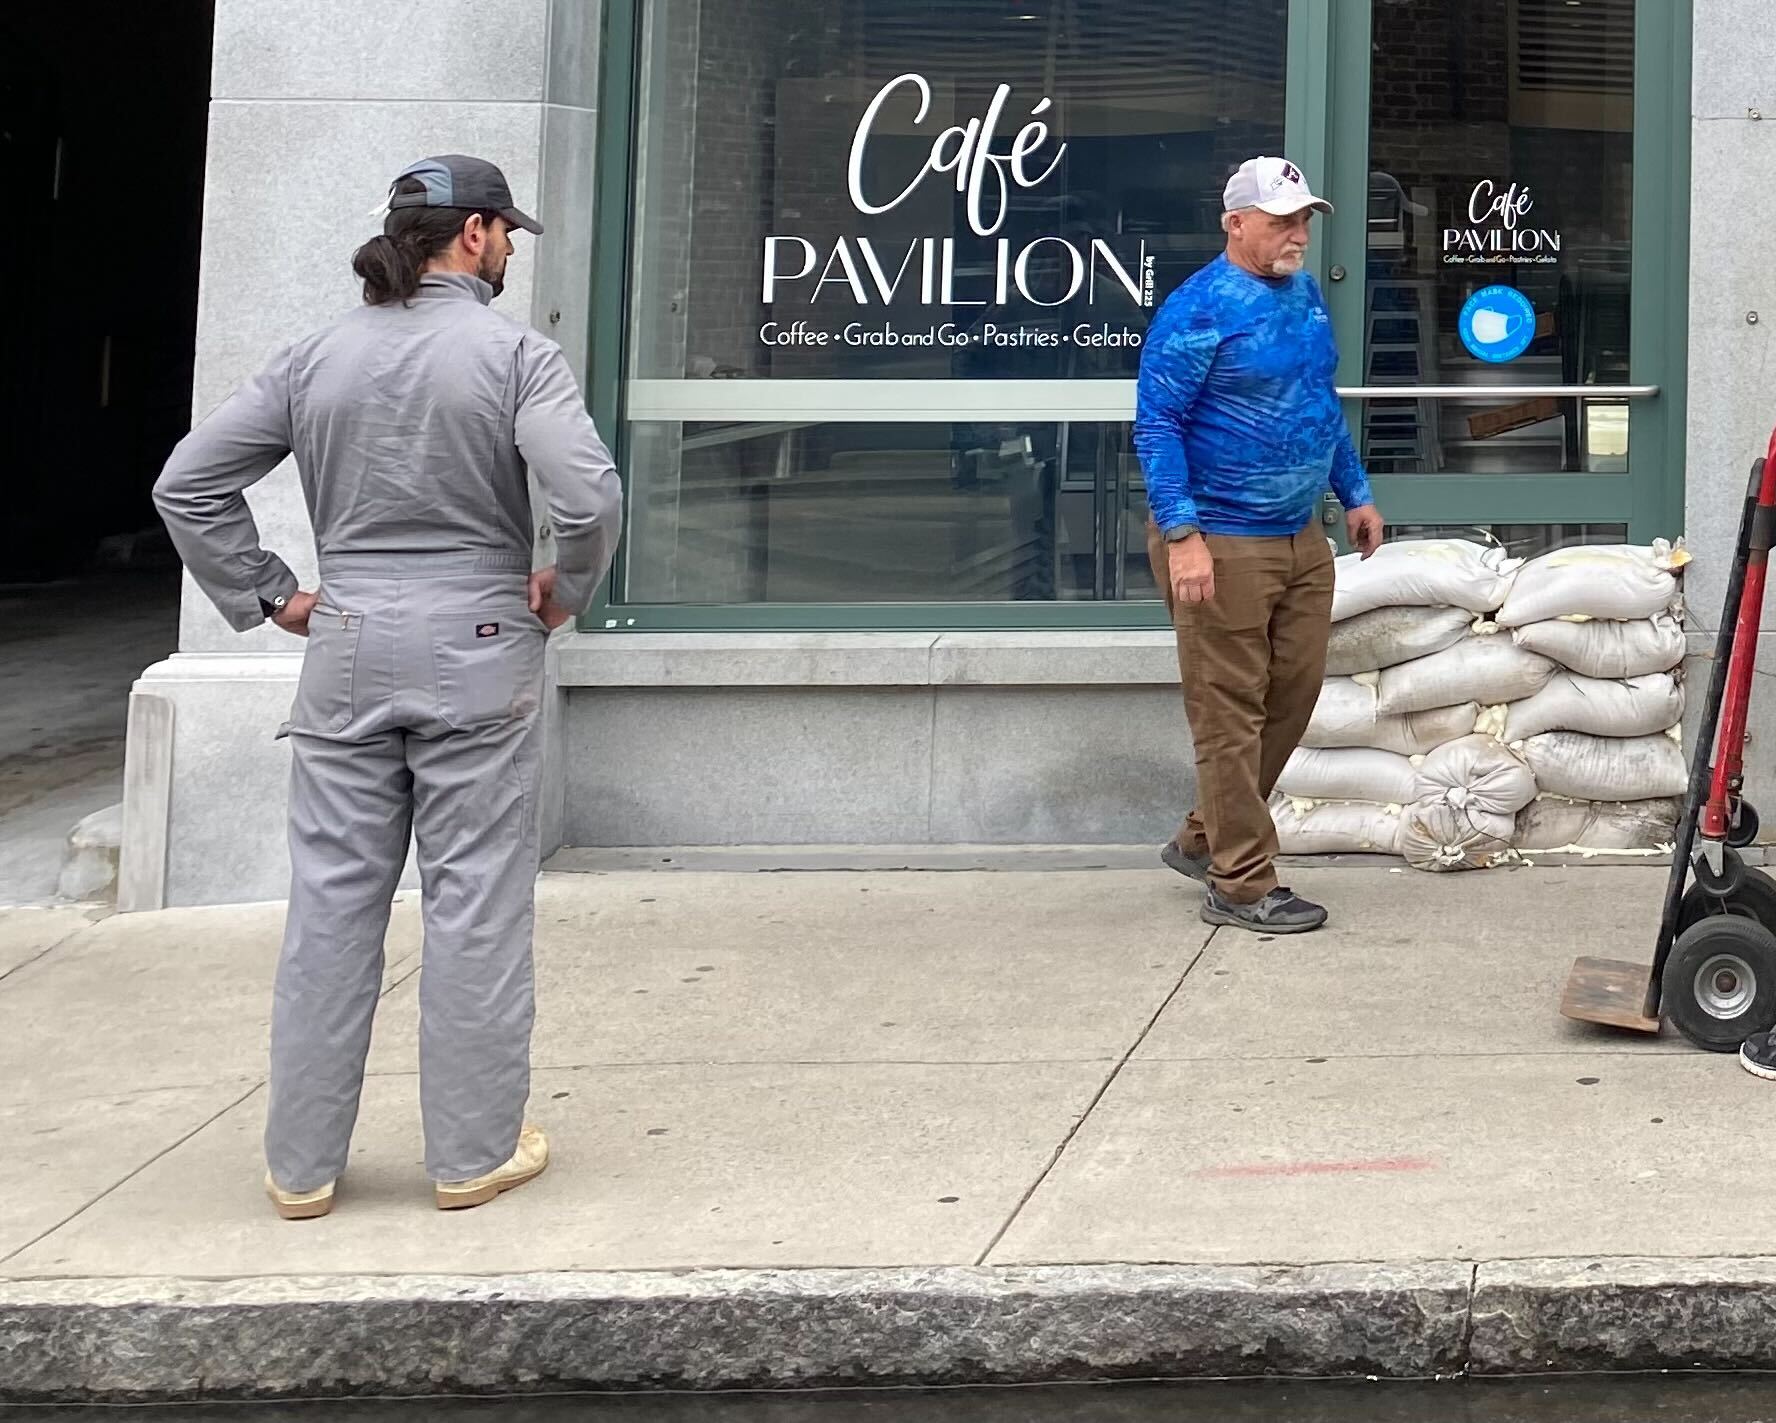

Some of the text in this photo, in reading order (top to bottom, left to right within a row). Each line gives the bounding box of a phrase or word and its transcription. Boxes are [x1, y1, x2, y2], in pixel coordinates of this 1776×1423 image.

[847, 73, 1067, 236] Café
[1468, 179, 1534, 231] Café
[1443, 228, 1558, 252] PAVILION
[762, 235, 1144, 307] PAVILION
[1144, 255, 1155, 268] by
[1144, 289, 1153, 307] 225
[759, 322, 1142, 348] Coffee Grab and Go Pastries Gelato
